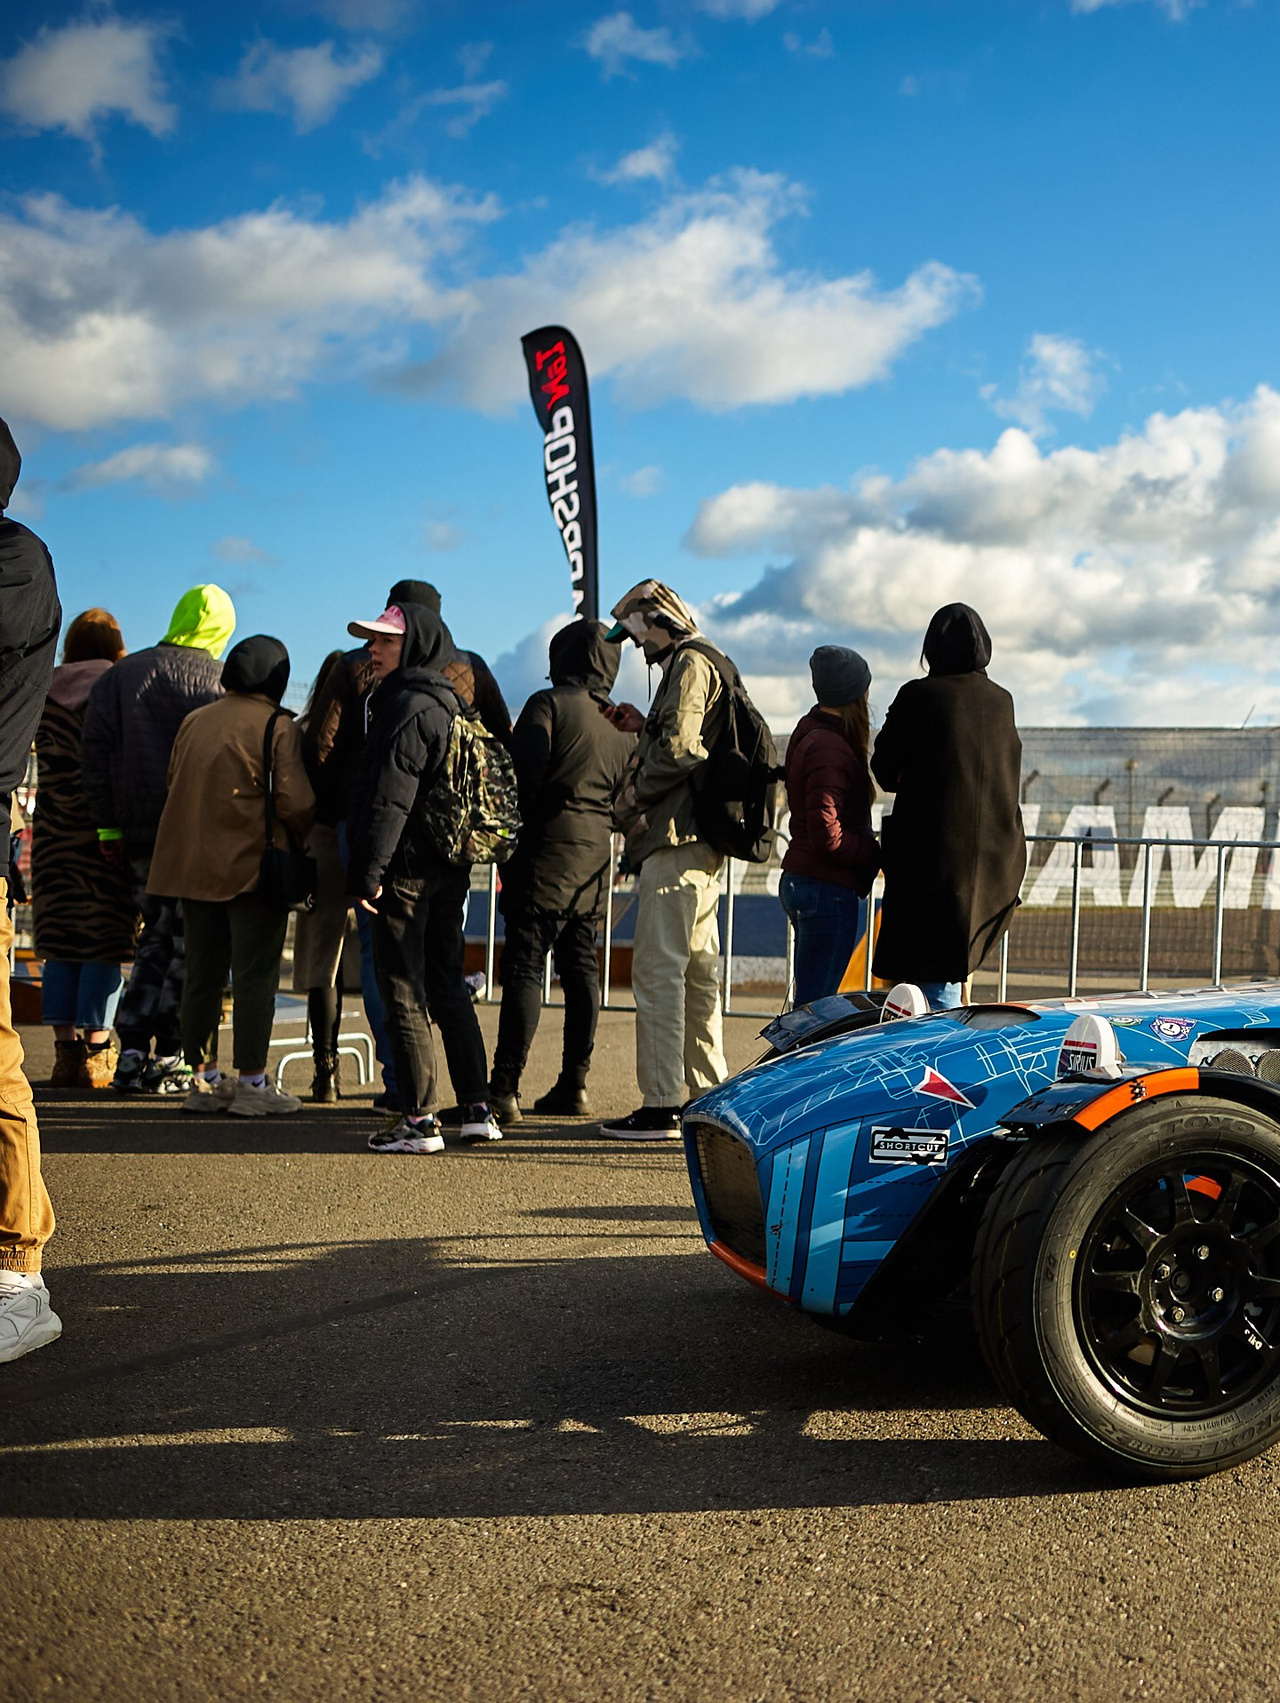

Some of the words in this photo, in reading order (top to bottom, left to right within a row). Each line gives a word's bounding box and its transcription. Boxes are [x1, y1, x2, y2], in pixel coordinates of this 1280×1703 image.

[1067, 1053, 1095, 1072] SIRIUS
[1159, 1116, 1256, 1137] TOYO
[879, 1141, 940, 1152] SHORTCUT
